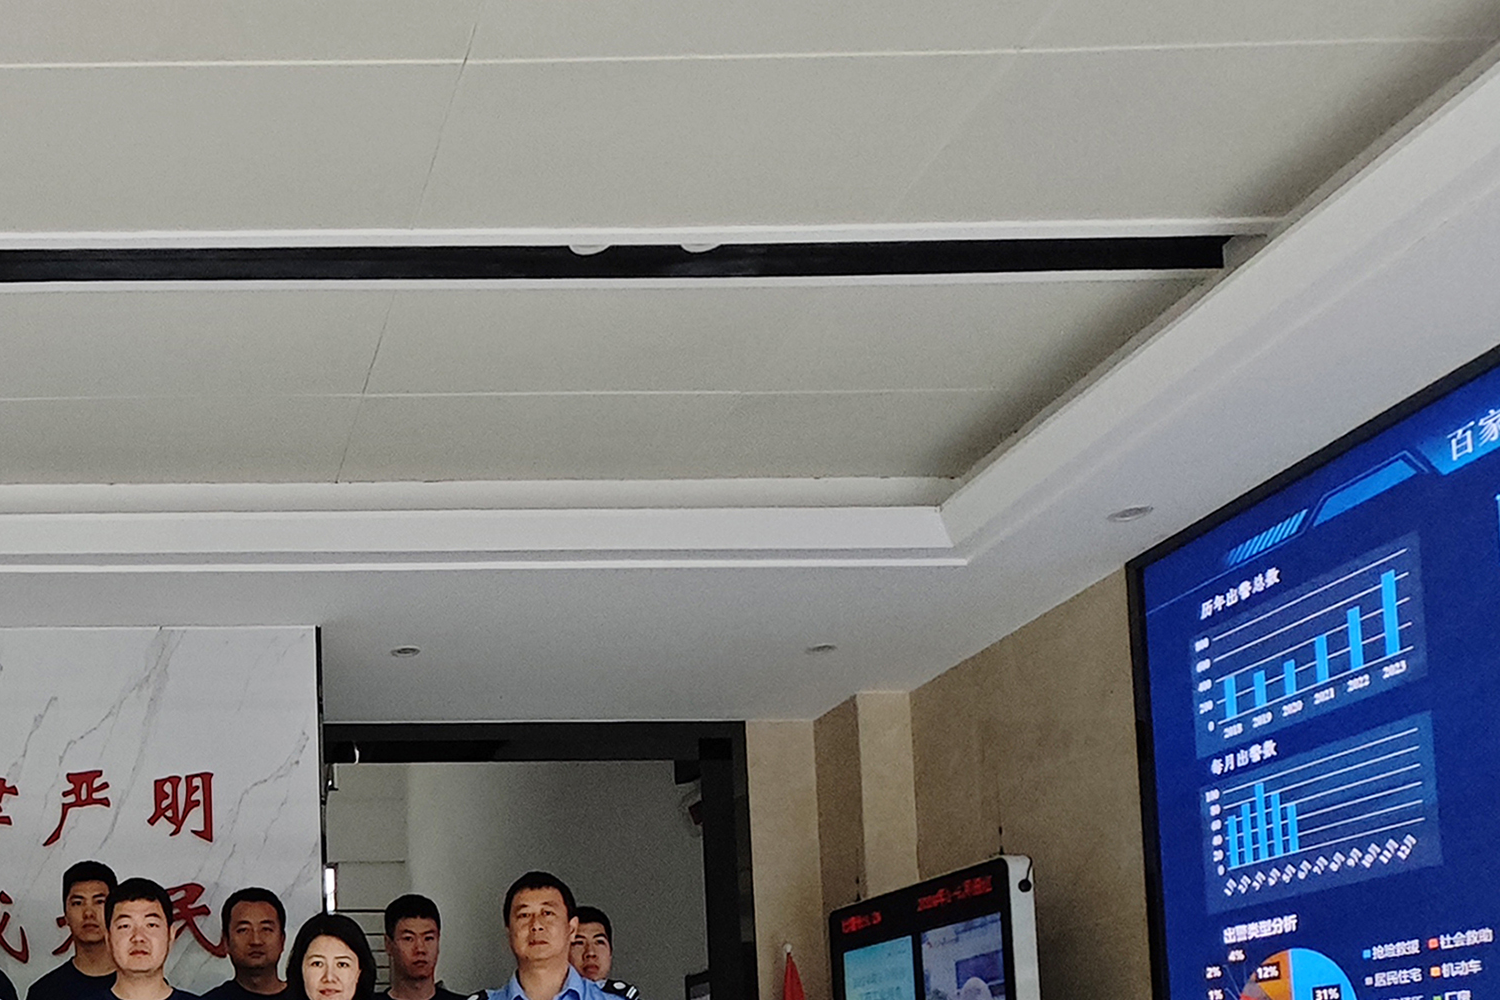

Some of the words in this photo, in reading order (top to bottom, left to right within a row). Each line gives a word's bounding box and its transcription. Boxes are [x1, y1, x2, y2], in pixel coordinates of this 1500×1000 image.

[1228, 949, 1245, 961] 4%
[1206, 966, 1222, 978] 2%
[1256, 966, 1279, 979] 12%
[1441, 959, 1482, 978] 机动车
[1374, 967, 1422, 987] 居民住宅
[1208, 989, 1223, 1000] 1%
[1315, 988, 1339, 1000] 31%
